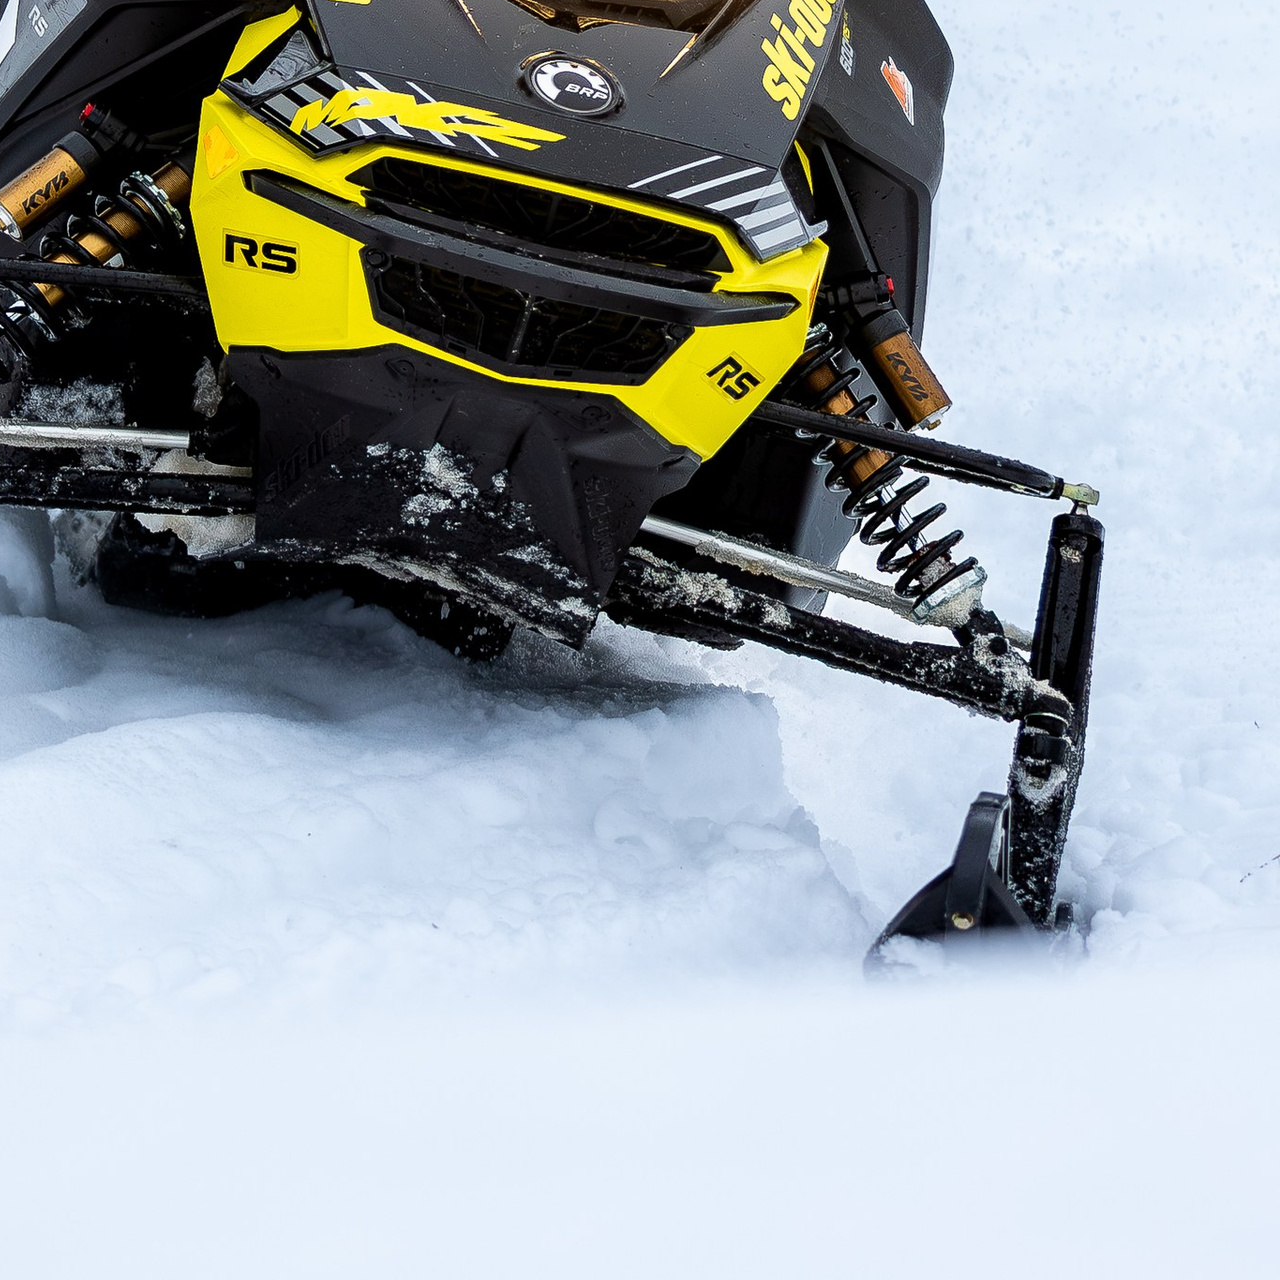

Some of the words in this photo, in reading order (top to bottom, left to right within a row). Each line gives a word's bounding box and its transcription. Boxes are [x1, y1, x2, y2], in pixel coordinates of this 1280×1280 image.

[28, 5, 49, 38] RS
[564, 83, 608, 100] BRP
[22, 171, 70, 216] KYB
[224, 234, 297, 274] RS
[706, 356, 761, 400] RS
